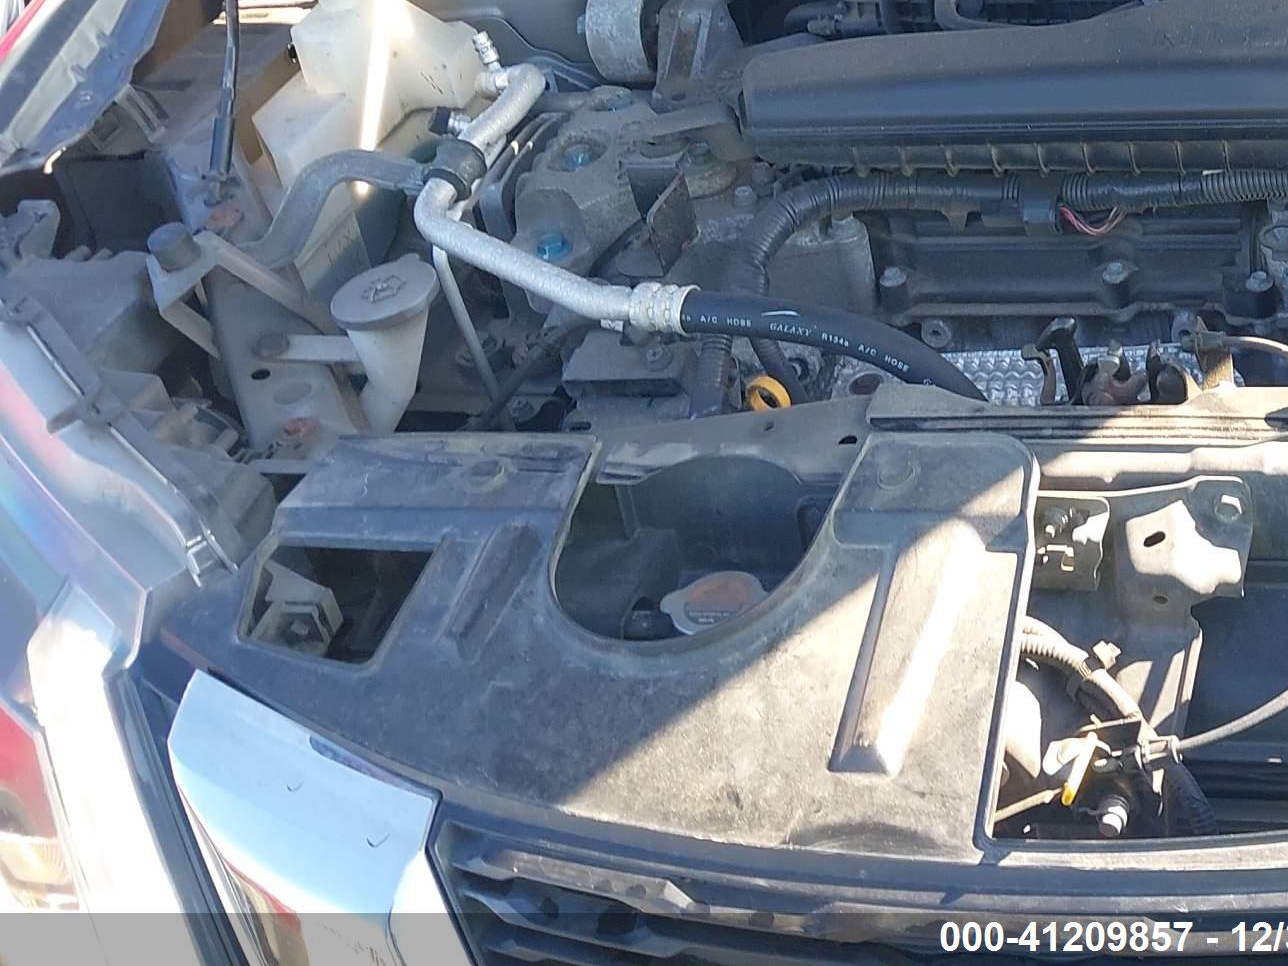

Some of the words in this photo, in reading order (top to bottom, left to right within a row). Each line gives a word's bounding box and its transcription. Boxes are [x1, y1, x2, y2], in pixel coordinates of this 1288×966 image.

[769, 322, 812, 337] GALAXY
[858, 344, 877, 356] A/C
[884, 355, 910, 372] HOSE
